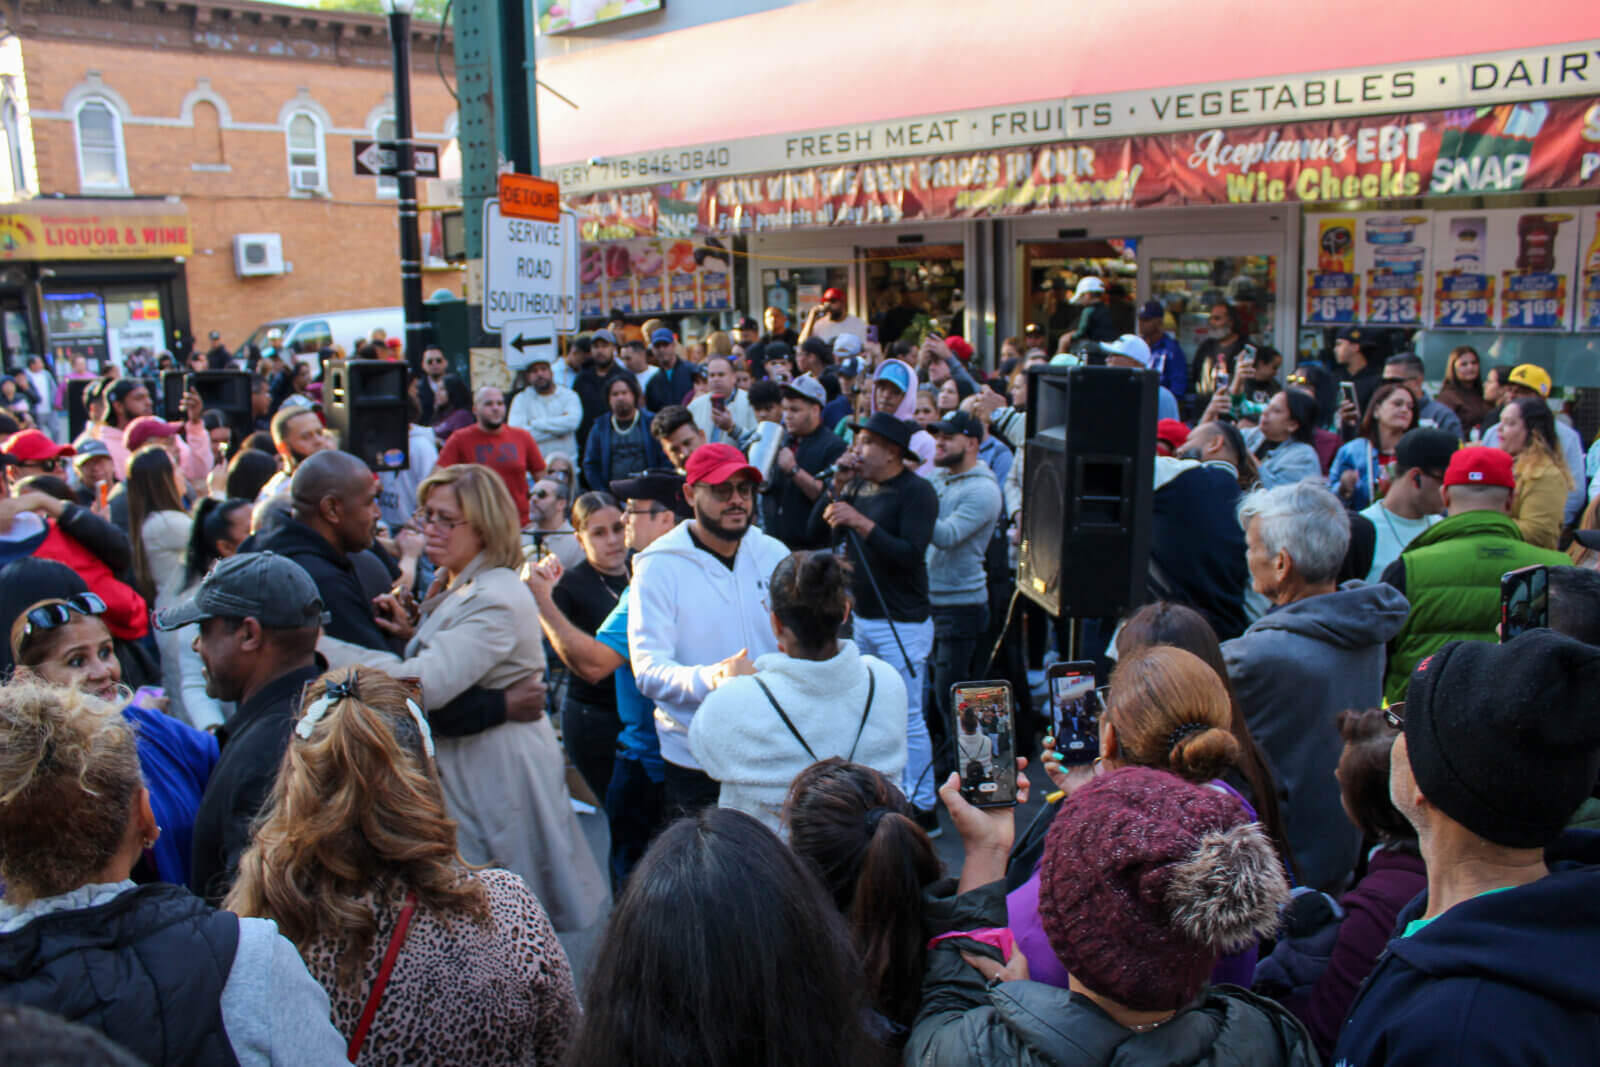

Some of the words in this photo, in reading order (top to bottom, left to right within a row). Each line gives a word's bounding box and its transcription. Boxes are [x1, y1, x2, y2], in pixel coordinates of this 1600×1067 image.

[1151, 71, 1415, 120] VEGETABLES
[1471, 50, 1600, 91] DAIR
[786, 129, 872, 158] FRESH
[885, 119, 958, 148] MEAT
[991, 103, 1112, 136] FRUITS
[1188, 128, 1355, 174] Aceptamos
[1357, 122, 1426, 163] EBT
[863, 161, 915, 193] BEST
[919, 153, 1000, 190] PRICES
[1005, 152, 1033, 181] IN
[1039, 145, 1096, 179] OUR
[1226, 172, 1285, 203] Wic
[1297, 163, 1421, 200] Checks
[1431, 153, 1530, 194] SNAP
[503, 185, 556, 209] DETOUR
[621, 192, 652, 218] EBT
[45, 227, 118, 246] LIQUOR
[125, 228, 136, 245] &
[142, 227, 187, 244] WINE
[508, 221, 561, 246] SERVICE
[517, 257, 552, 280] ROAD
[489, 291, 574, 315] SOUTHBOUND
